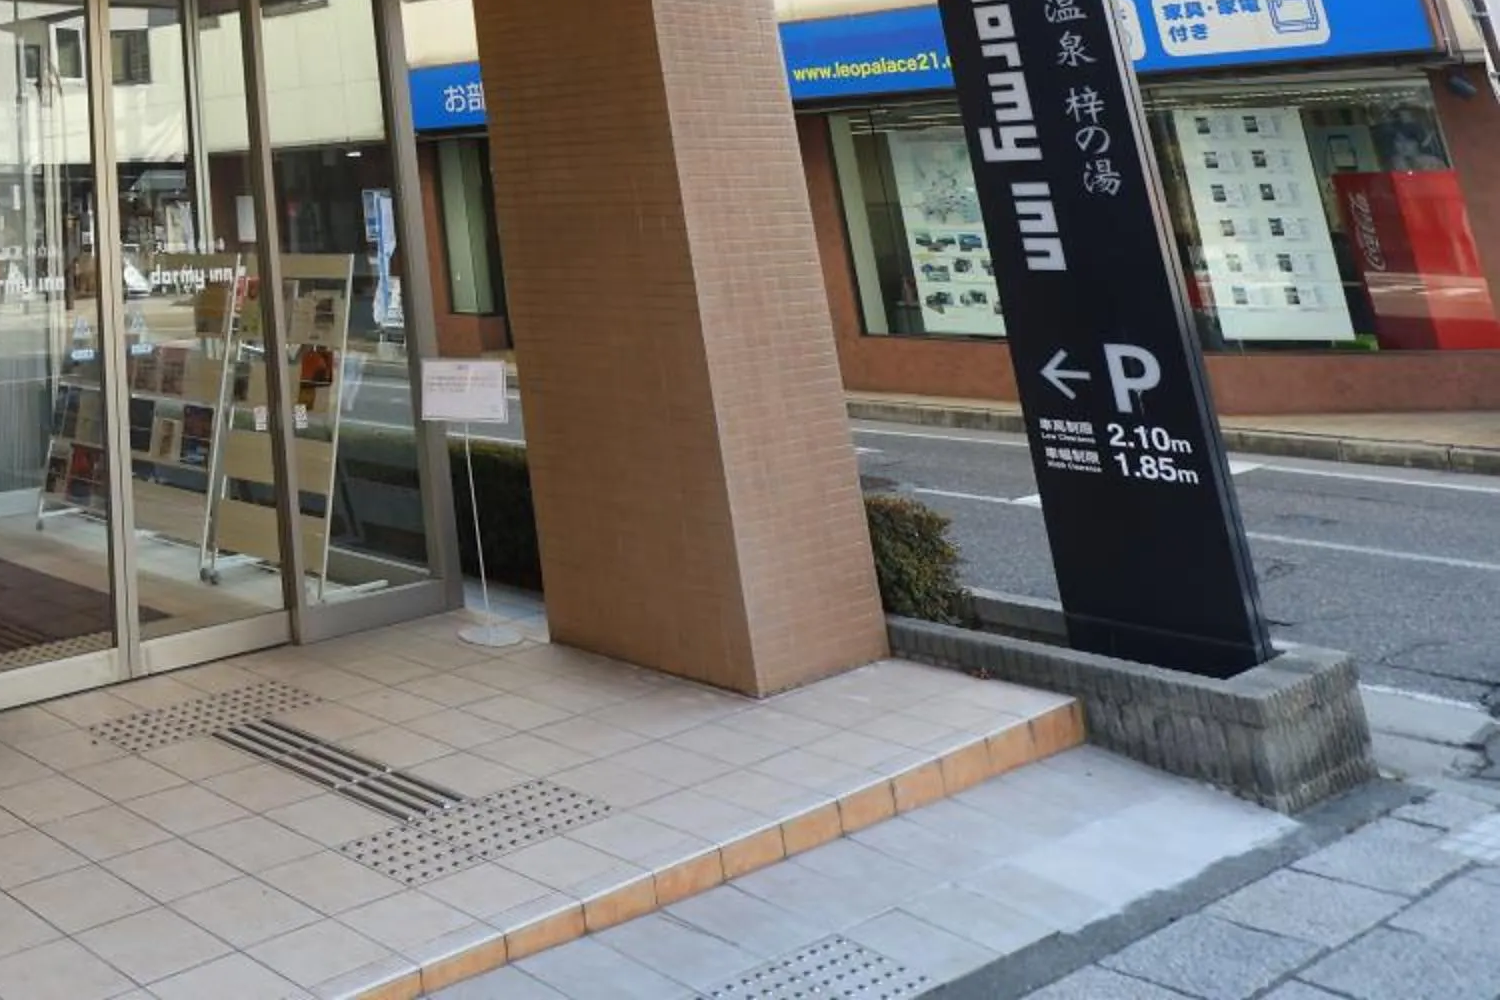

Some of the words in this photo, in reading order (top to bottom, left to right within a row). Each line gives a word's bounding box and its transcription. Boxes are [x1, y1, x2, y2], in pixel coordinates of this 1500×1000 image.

[1169, 23, 1209, 43] 付き
[1065, 86, 1122, 196] 梓の湯
[1011, 181, 1067, 271] inn
[1104, 343, 1161, 413] P
[1107, 423, 1193, 454] 2.10m
[1114, 452, 1200, 484] 1.85m
